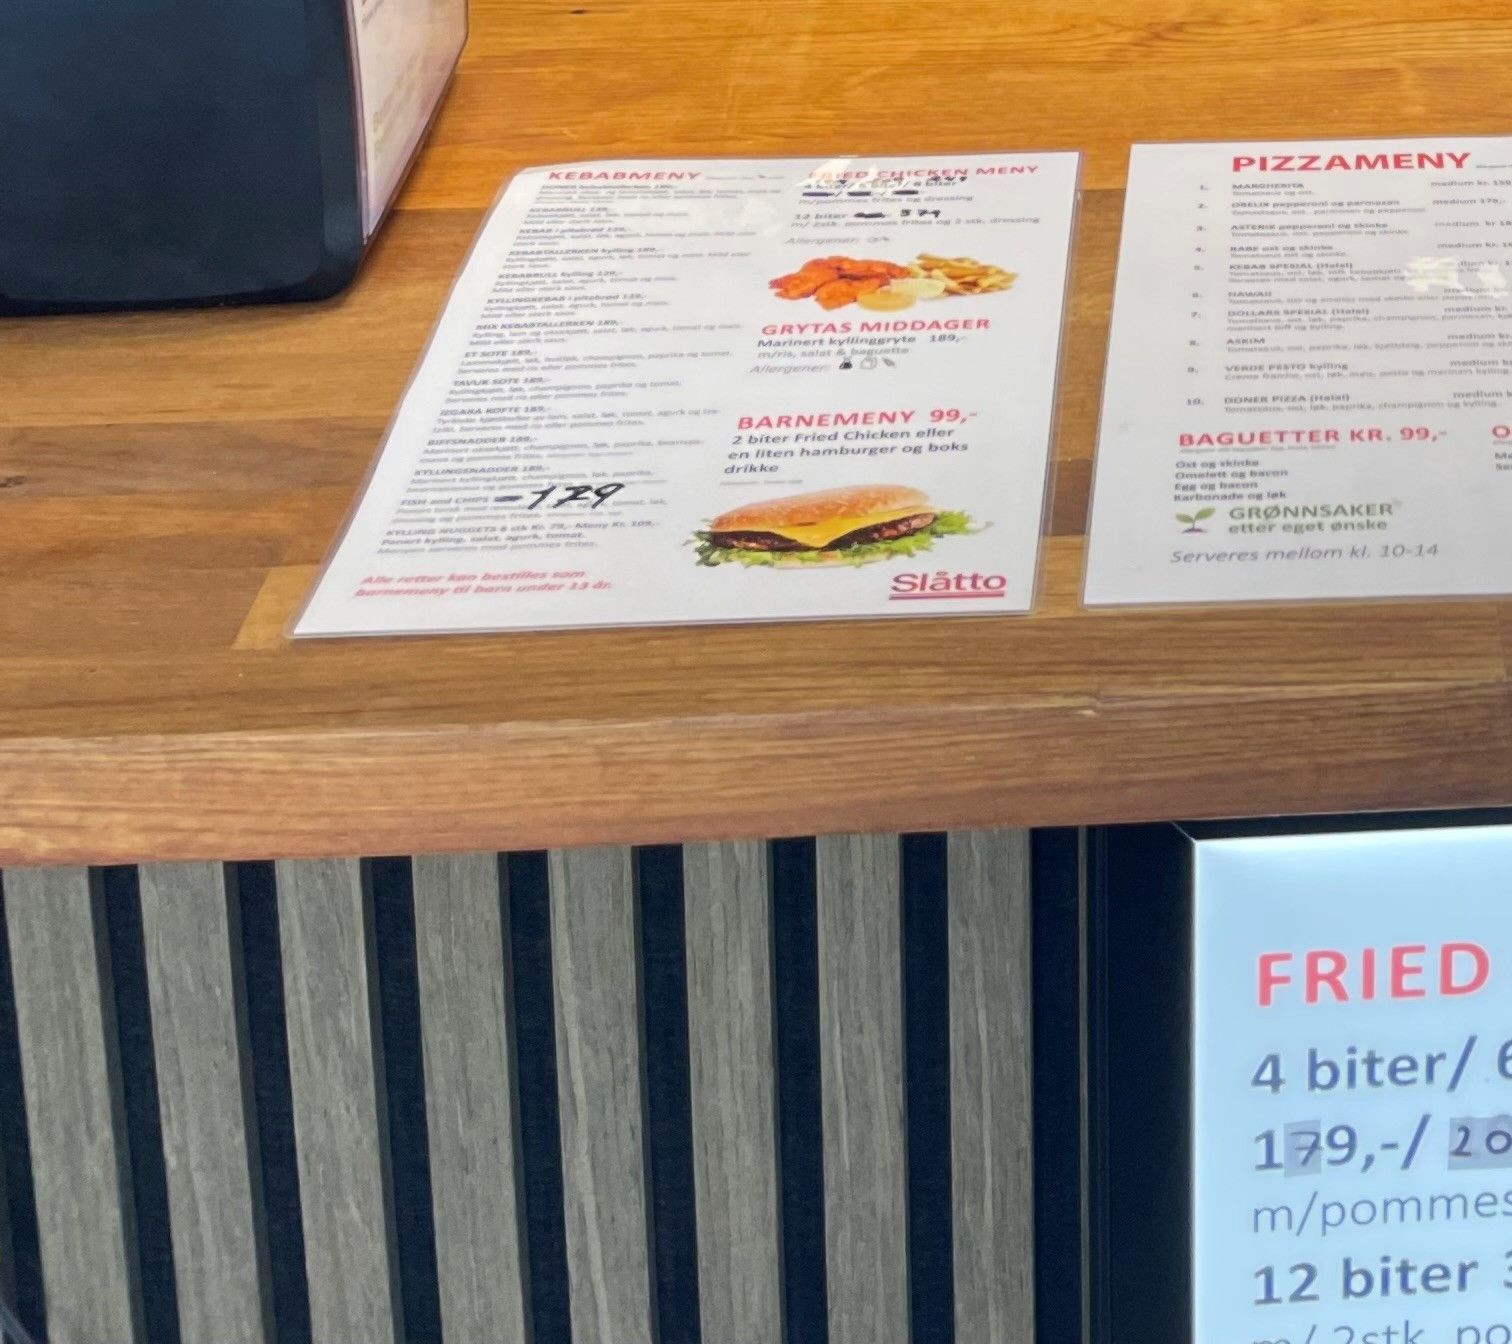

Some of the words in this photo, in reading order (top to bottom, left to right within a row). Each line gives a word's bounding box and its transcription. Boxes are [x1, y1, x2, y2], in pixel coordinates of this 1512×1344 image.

[1232, 152, 1471, 173] PIZZAMENY
[549, 172, 702, 180] KEBABMENY
[761, 322, 853, 336] GRYTAS
[860, 318, 990, 332] MIDDAGER
[758, 338, 824, 348] Marinert
[828, 335, 916, 346] kyllinggryte
[800, 348, 832, 357] salat
[836, 348, 846, 356] &
[851, 346, 909, 356] baguette
[737, 410, 916, 430] BARNEMENY
[929, 408, 978, 425] 99,-
[732, 436, 743, 444] 2
[748, 434, 788, 444] biter
[794, 432, 838, 442] Fried
[843, 430, 911, 440] Chicken
[916, 428, 954, 438] eller
[1179, 430, 1340, 447] BAGUETTER
[1350, 428, 1392, 442] KR.
[1400, 427, 1447, 442] 99,-
[728, 451, 750, 460] en
[755, 448, 794, 458] liten
[800, 444, 896, 456] hamburger
[902, 444, 923, 455] og
[928, 442, 968, 452] boks
[724, 464, 778, 474] drikke
[1228, 502, 1393, 521] GRØNNSAKER
[1228, 522, 1276, 534] etter
[1282, 521, 1324, 534] eget
[1331, 519, 1387, 532] ønske
[1170, 550, 1258, 563] Serveres
[1265, 547, 1343, 561] mellom
[1349, 545, 1369, 559] kl.
[1380, 543, 1439, 558] 10-14
[481, 570, 547, 582] bestilles
[891, 571, 1007, 593] Slåtto
[474, 584, 513, 594] barn
[516, 582, 564, 592] under
[1255, 940, 1493, 1008] FRIED
[1250, 1050, 1287, 1096] 4
[1306, 1034, 1478, 1094] biter/
[1253, 1115, 1431, 1174] 179,-/
[1253, 1262, 1319, 1305] 12
[1341, 1255, 1478, 1300] biter
